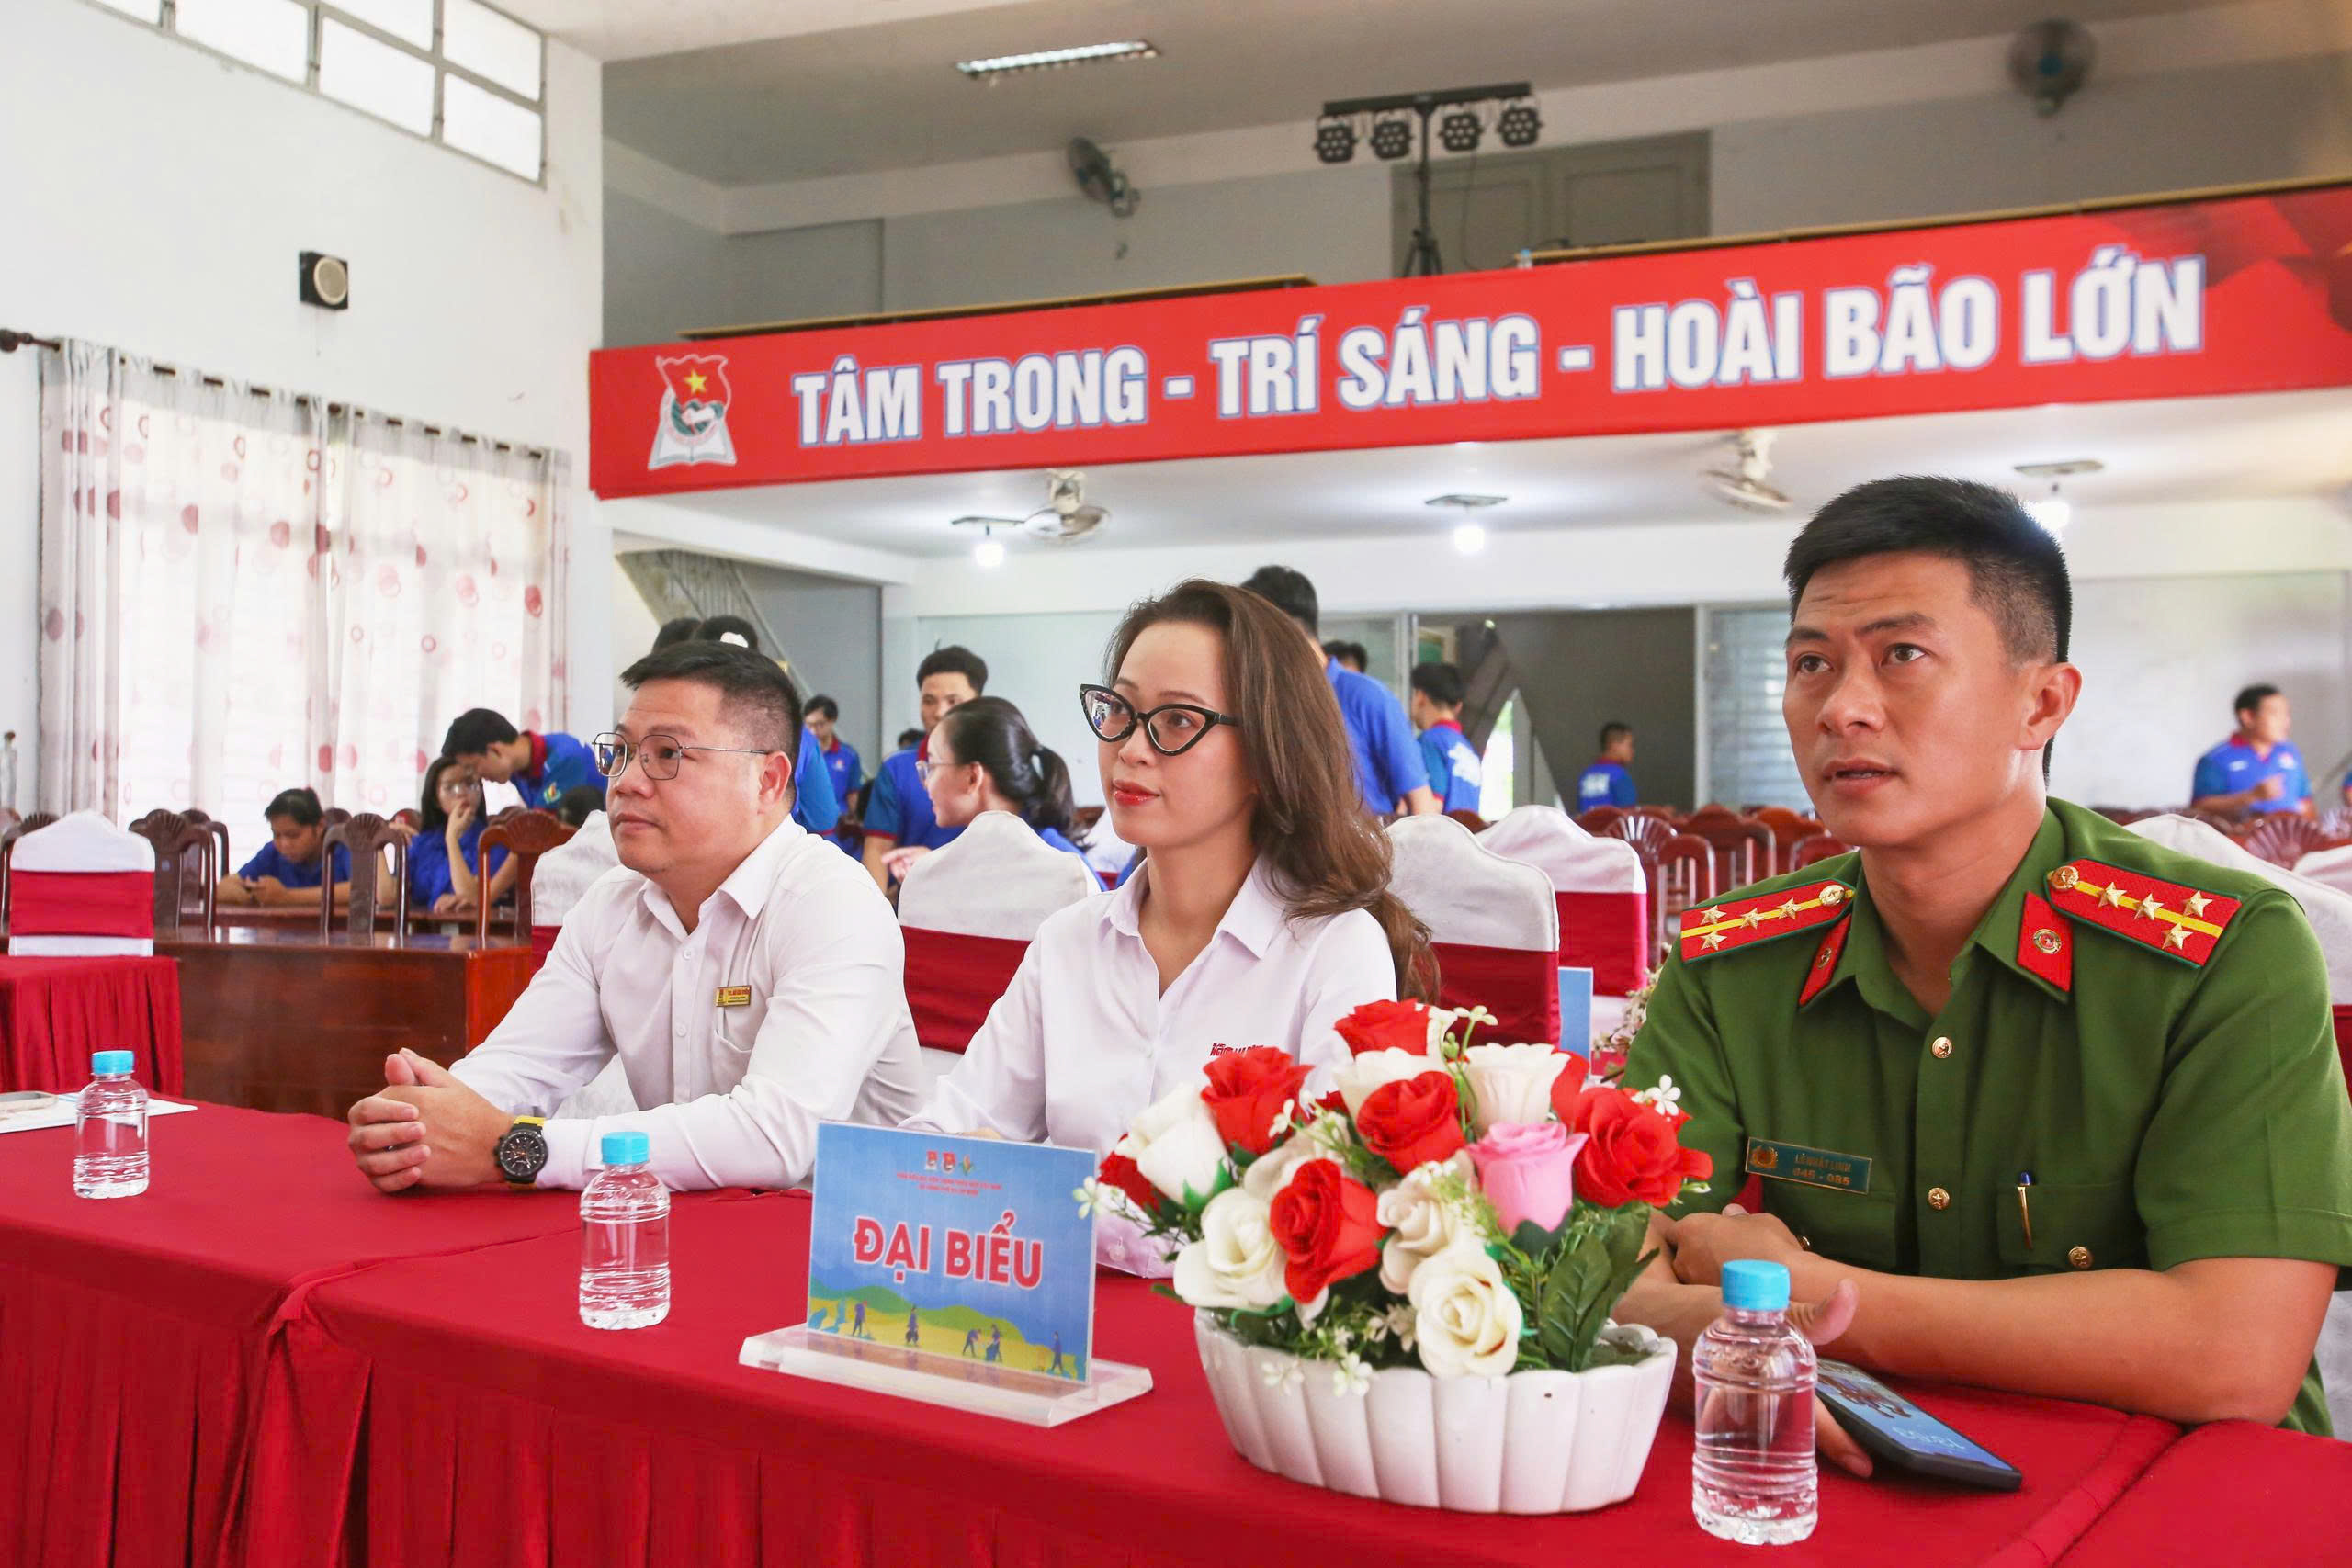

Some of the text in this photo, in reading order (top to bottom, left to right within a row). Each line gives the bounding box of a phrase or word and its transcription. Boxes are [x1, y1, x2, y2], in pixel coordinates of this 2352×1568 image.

[791, 243, 2205, 449] TÂM TRONG - TRÍ SÁNG - HOÀI BÃO LỚN
[854, 1209, 1044, 1290] ĐẠI BIỂU
